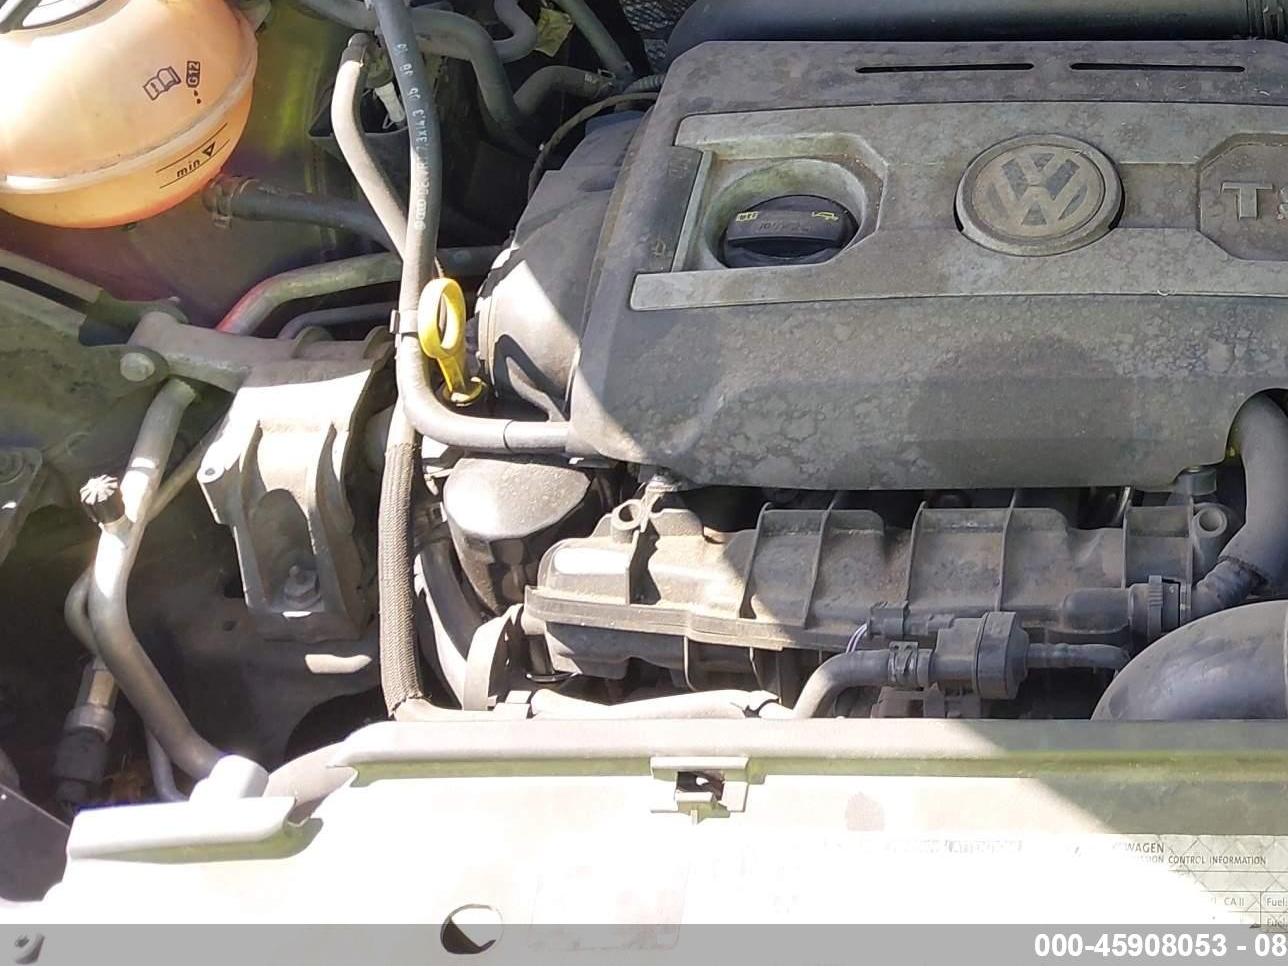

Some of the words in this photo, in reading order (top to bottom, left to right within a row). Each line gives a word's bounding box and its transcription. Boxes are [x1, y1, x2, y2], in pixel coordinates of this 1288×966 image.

[187, 61, 200, 85] G12
[176, 159, 200, 178] min
[1168, 855, 1205, 865] CONTROL
[1209, 856, 1266, 865] INFORMATION
[1266, 898, 1287, 907] Fuel:
